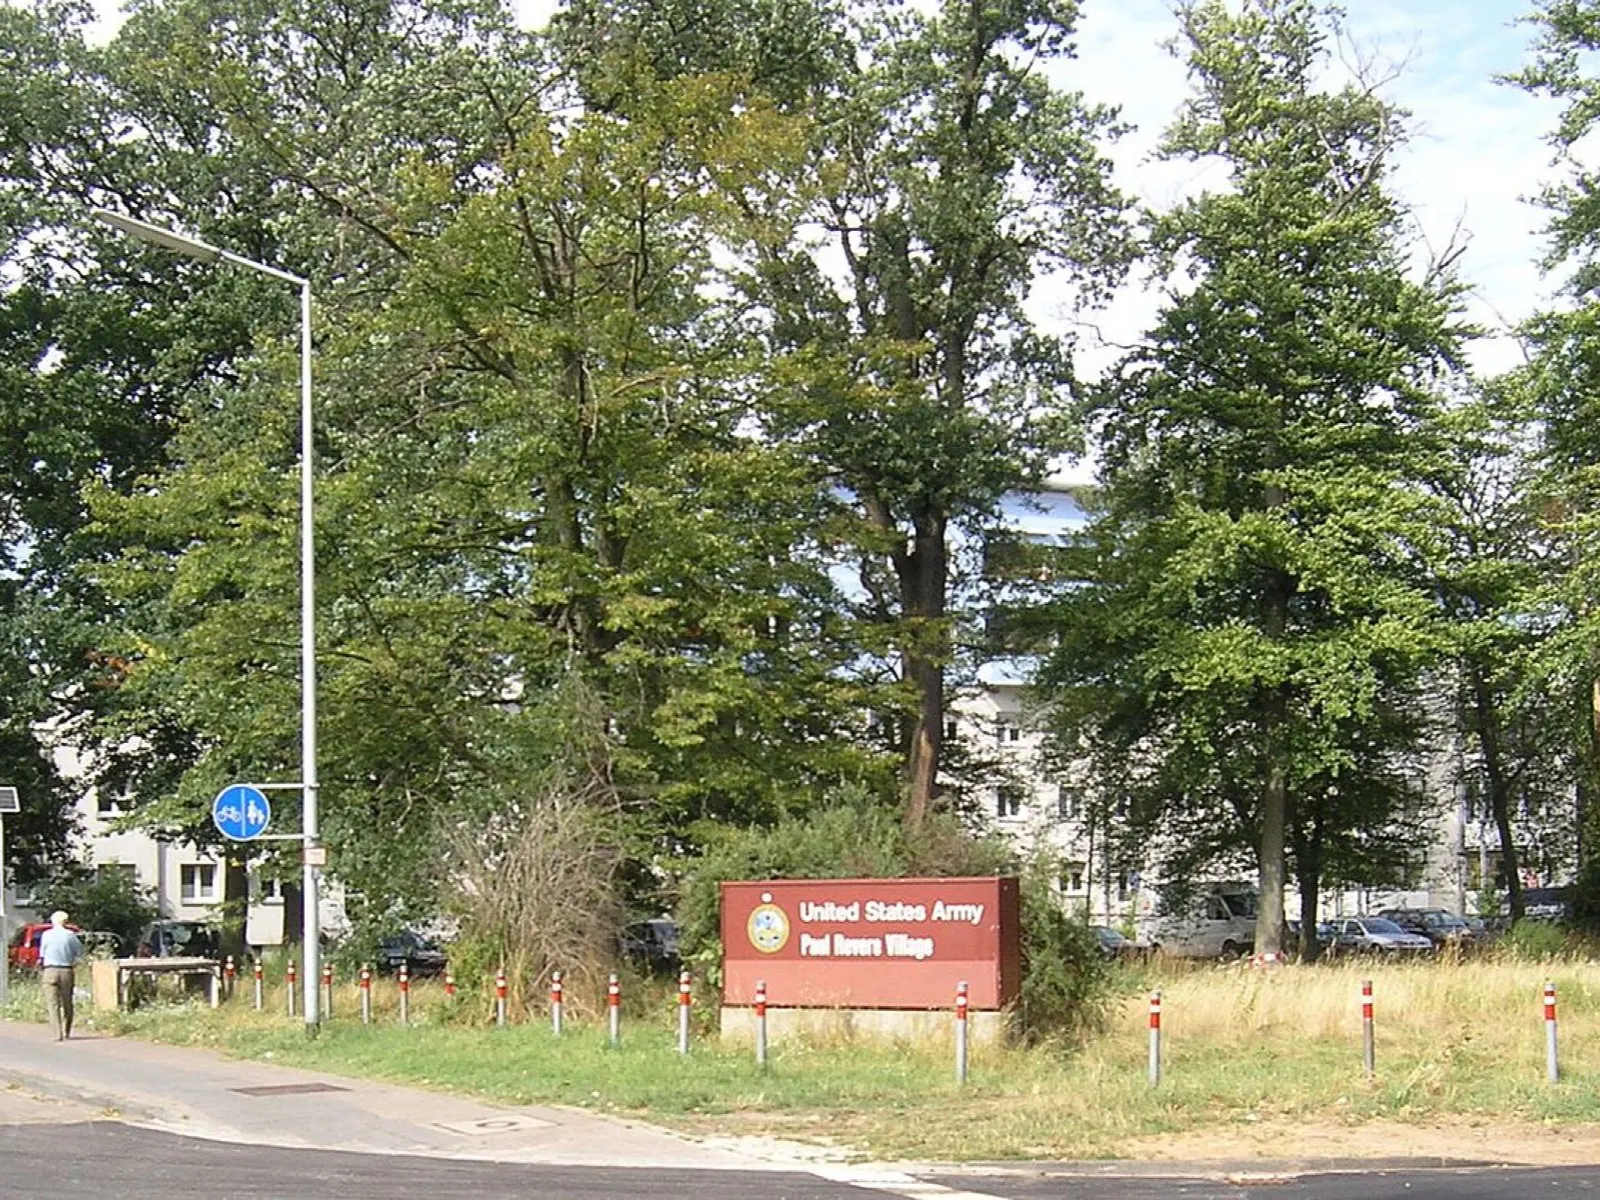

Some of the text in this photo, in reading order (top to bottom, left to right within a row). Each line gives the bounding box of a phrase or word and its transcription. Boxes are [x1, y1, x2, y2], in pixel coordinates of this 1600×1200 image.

[800, 900, 984, 925] United States Army
[884, 933, 934, 960] Village
